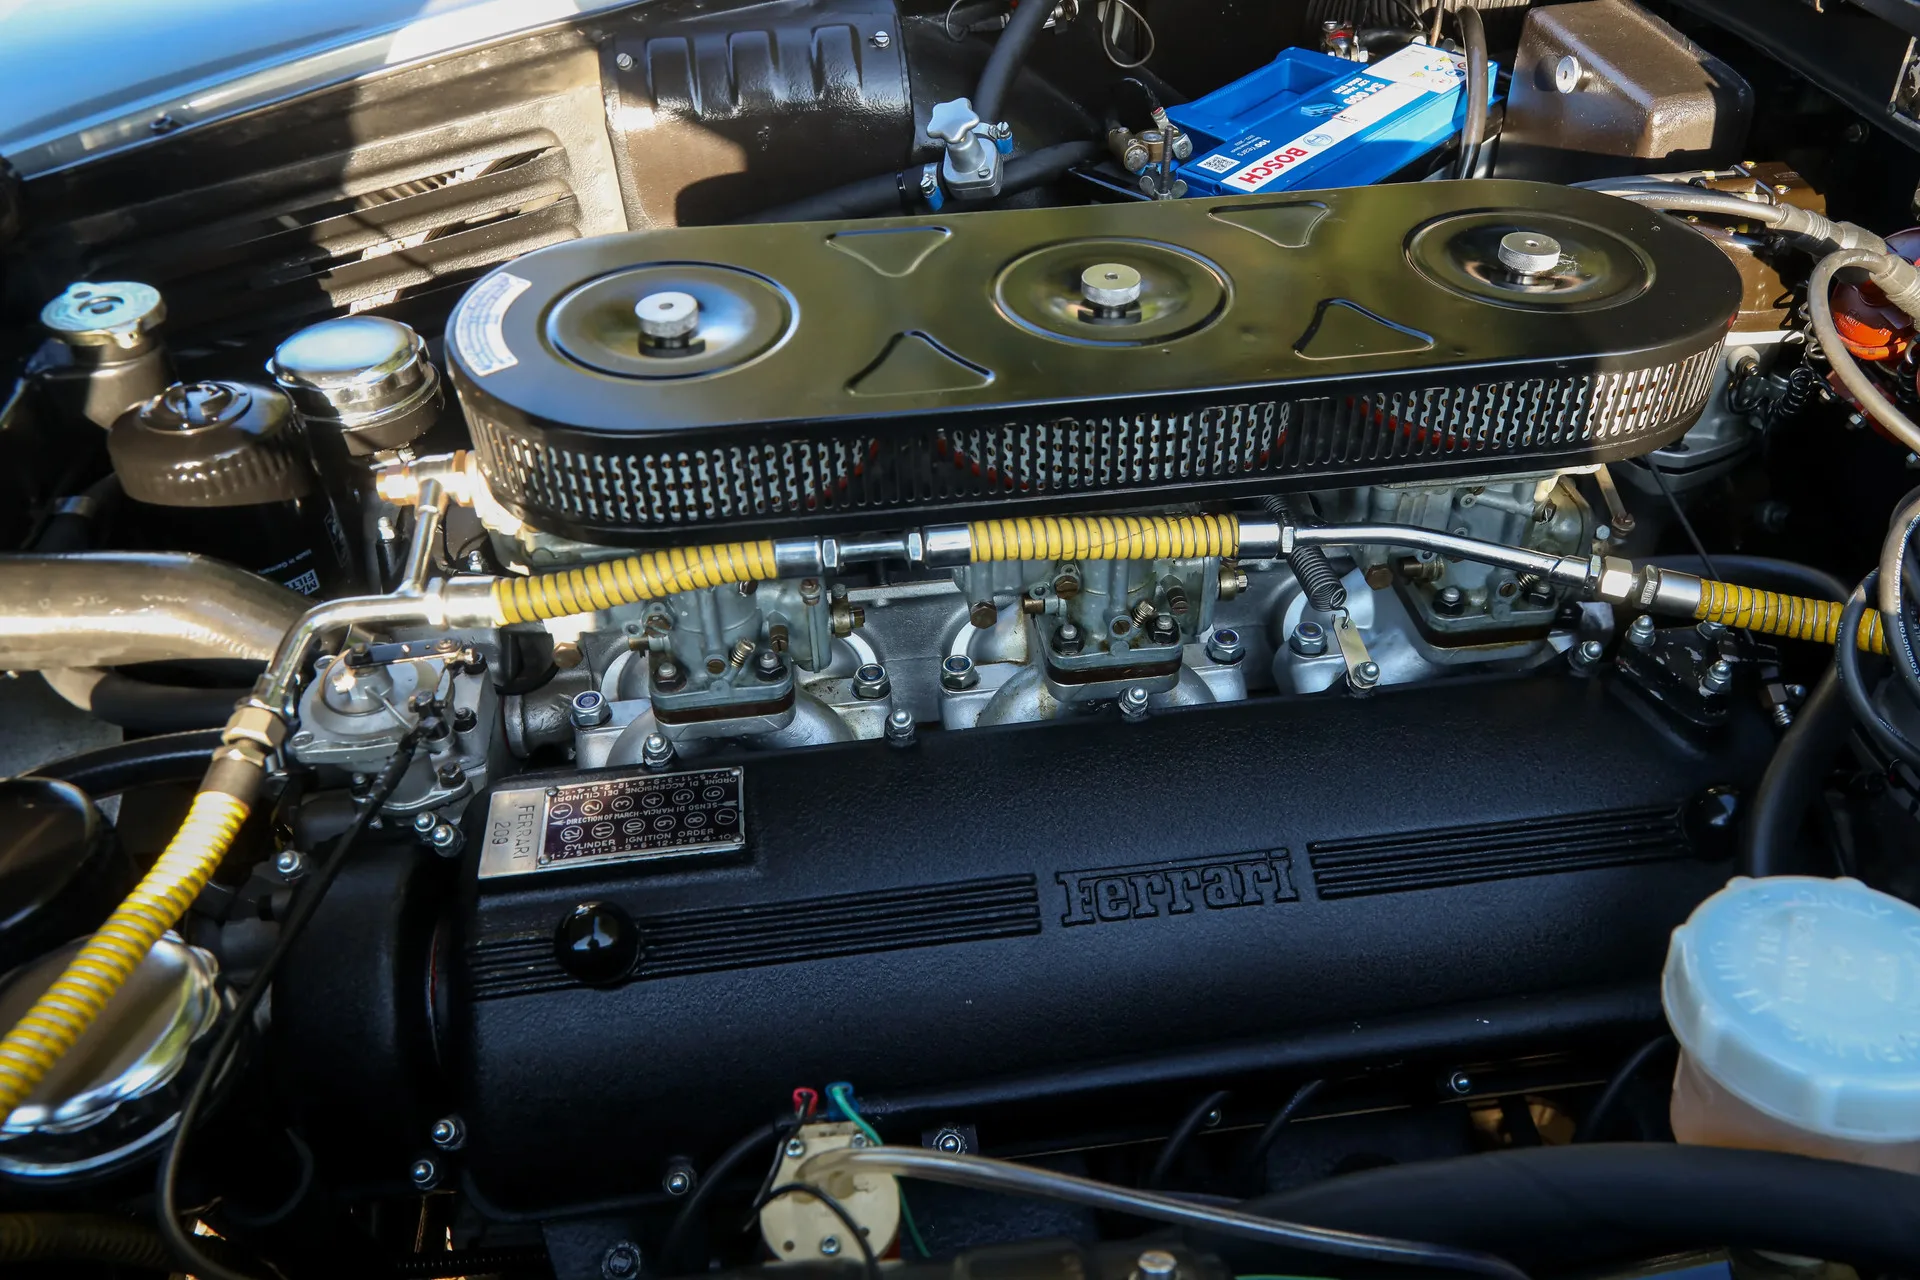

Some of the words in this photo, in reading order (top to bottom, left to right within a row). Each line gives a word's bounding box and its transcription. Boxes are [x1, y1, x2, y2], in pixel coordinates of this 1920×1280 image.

[1238, 147, 1309, 185] BOSCH
[1898, 621, 1920, 675] CONDUCTOR
[625, 782, 686, 794] ACCENSIONE
[704, 776, 737, 786] ORDINE
[553, 791, 600, 803] CILINDRI
[603, 789, 619, 797] DEI
[688, 802, 717, 811] SENSO
[566, 814, 603, 825] DIRECTION
[604, 812, 613, 821] OF
[491, 820, 511, 846] 209
[512, 804, 536, 860] FERRARI
[564, 839, 616, 851] CYLINDER
[625, 832, 671, 844] IGNITION
[677, 828, 714, 838] ORDER
[1054, 847, 1300, 928] Ferrari
